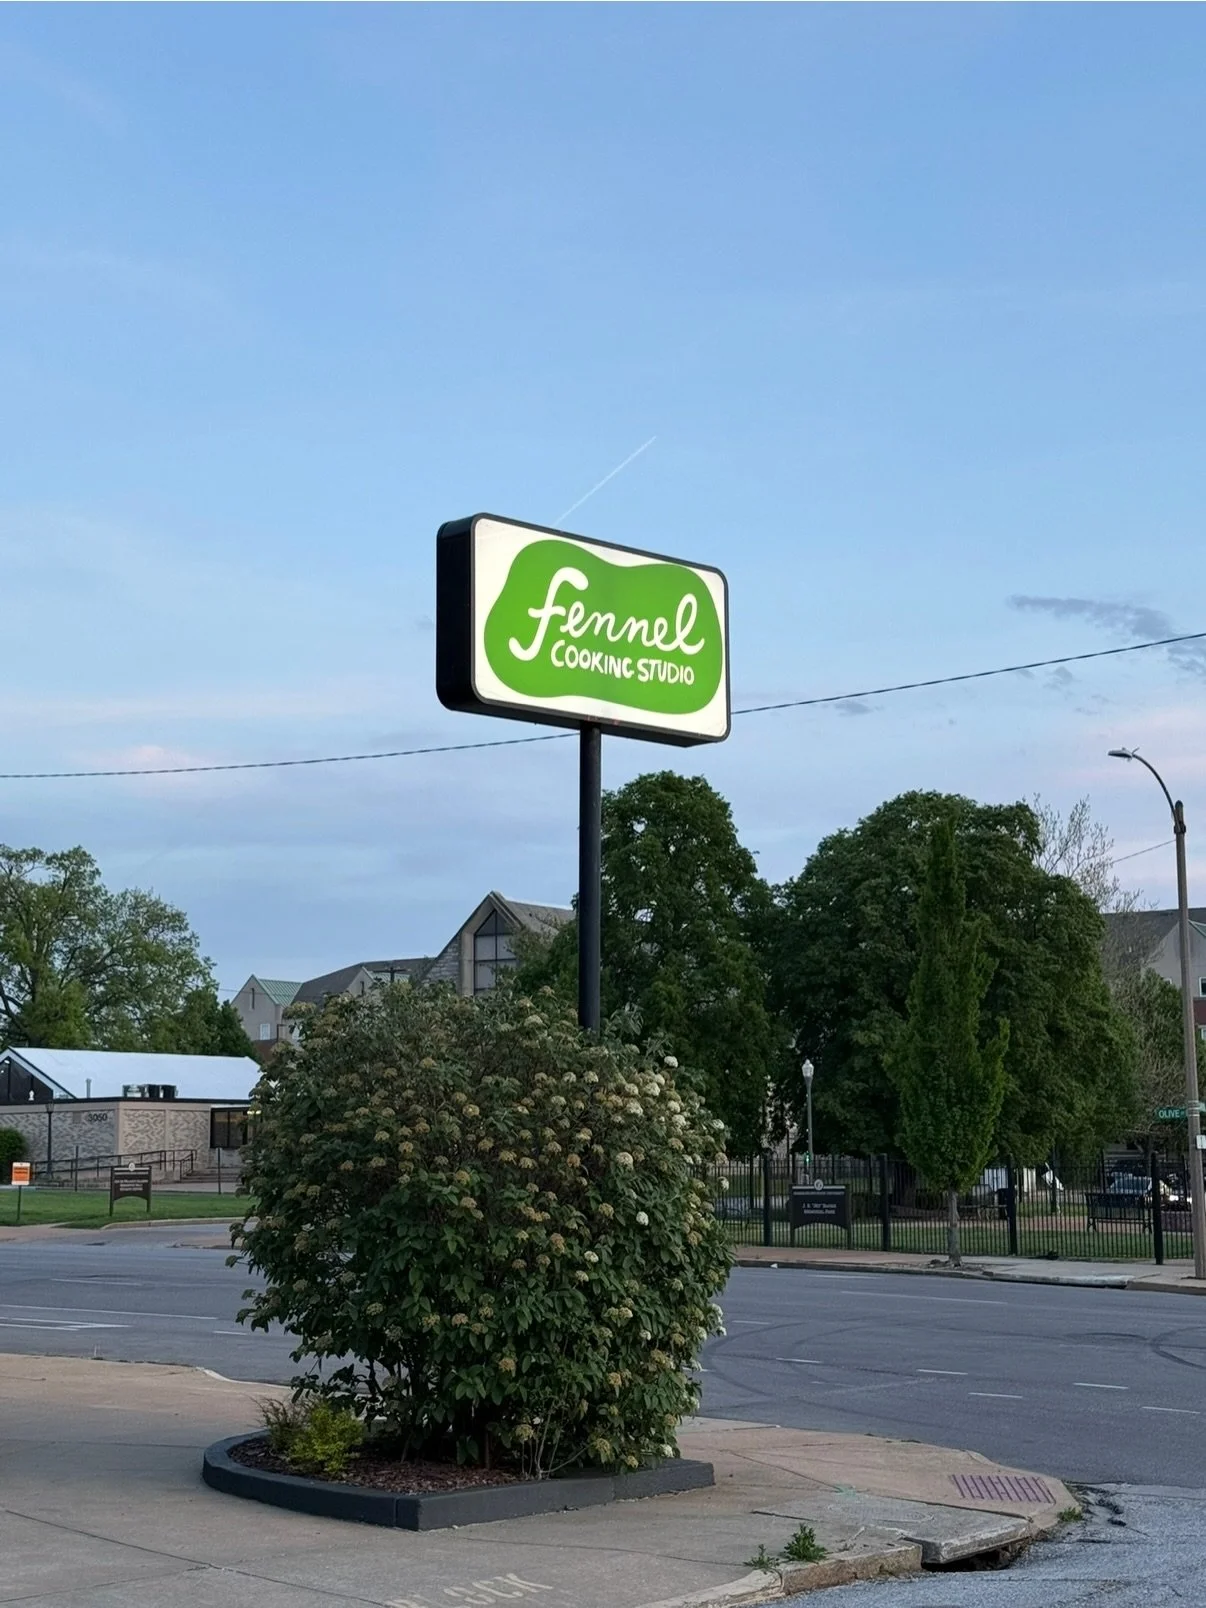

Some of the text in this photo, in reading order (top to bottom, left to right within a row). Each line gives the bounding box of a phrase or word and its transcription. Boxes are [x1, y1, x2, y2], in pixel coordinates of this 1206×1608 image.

[508, 567, 705, 661] fennel
[550, 640, 695, 685] COOKING STUDIO
[88, 1113, 108, 1122] 3050
[1159, 1109, 1180, 1118] OLIVE
